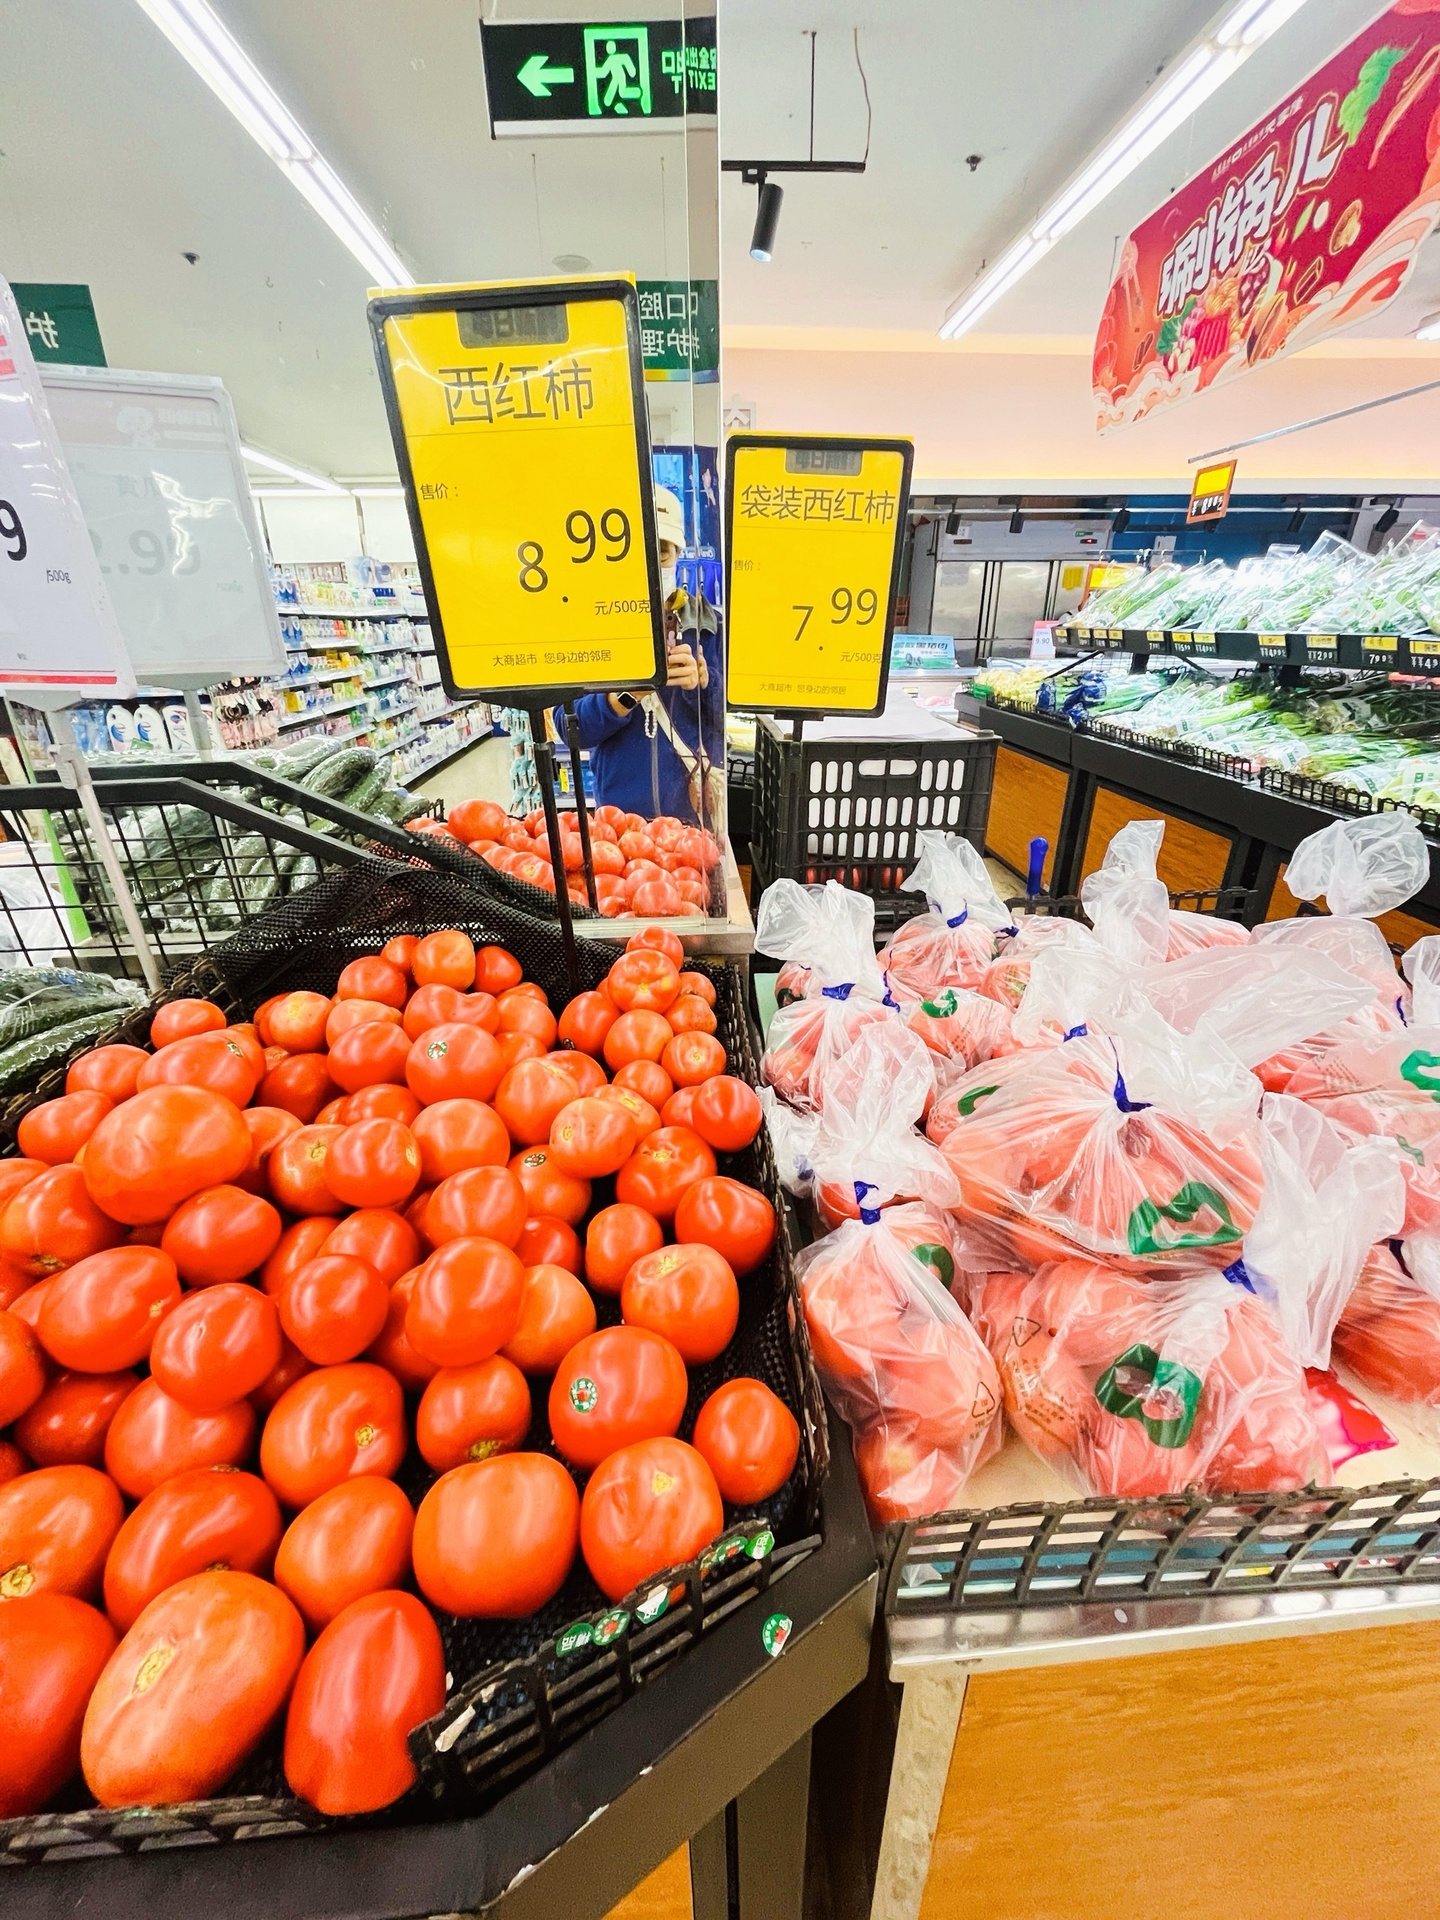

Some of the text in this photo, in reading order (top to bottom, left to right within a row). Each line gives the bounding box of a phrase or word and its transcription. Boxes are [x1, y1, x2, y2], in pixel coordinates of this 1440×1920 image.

[439, 360, 594, 427] 西红柿
[740, 484, 896, 525] 袋装西红柿
[492, 649, 611, 667] 大商超市 您身边的邻居
